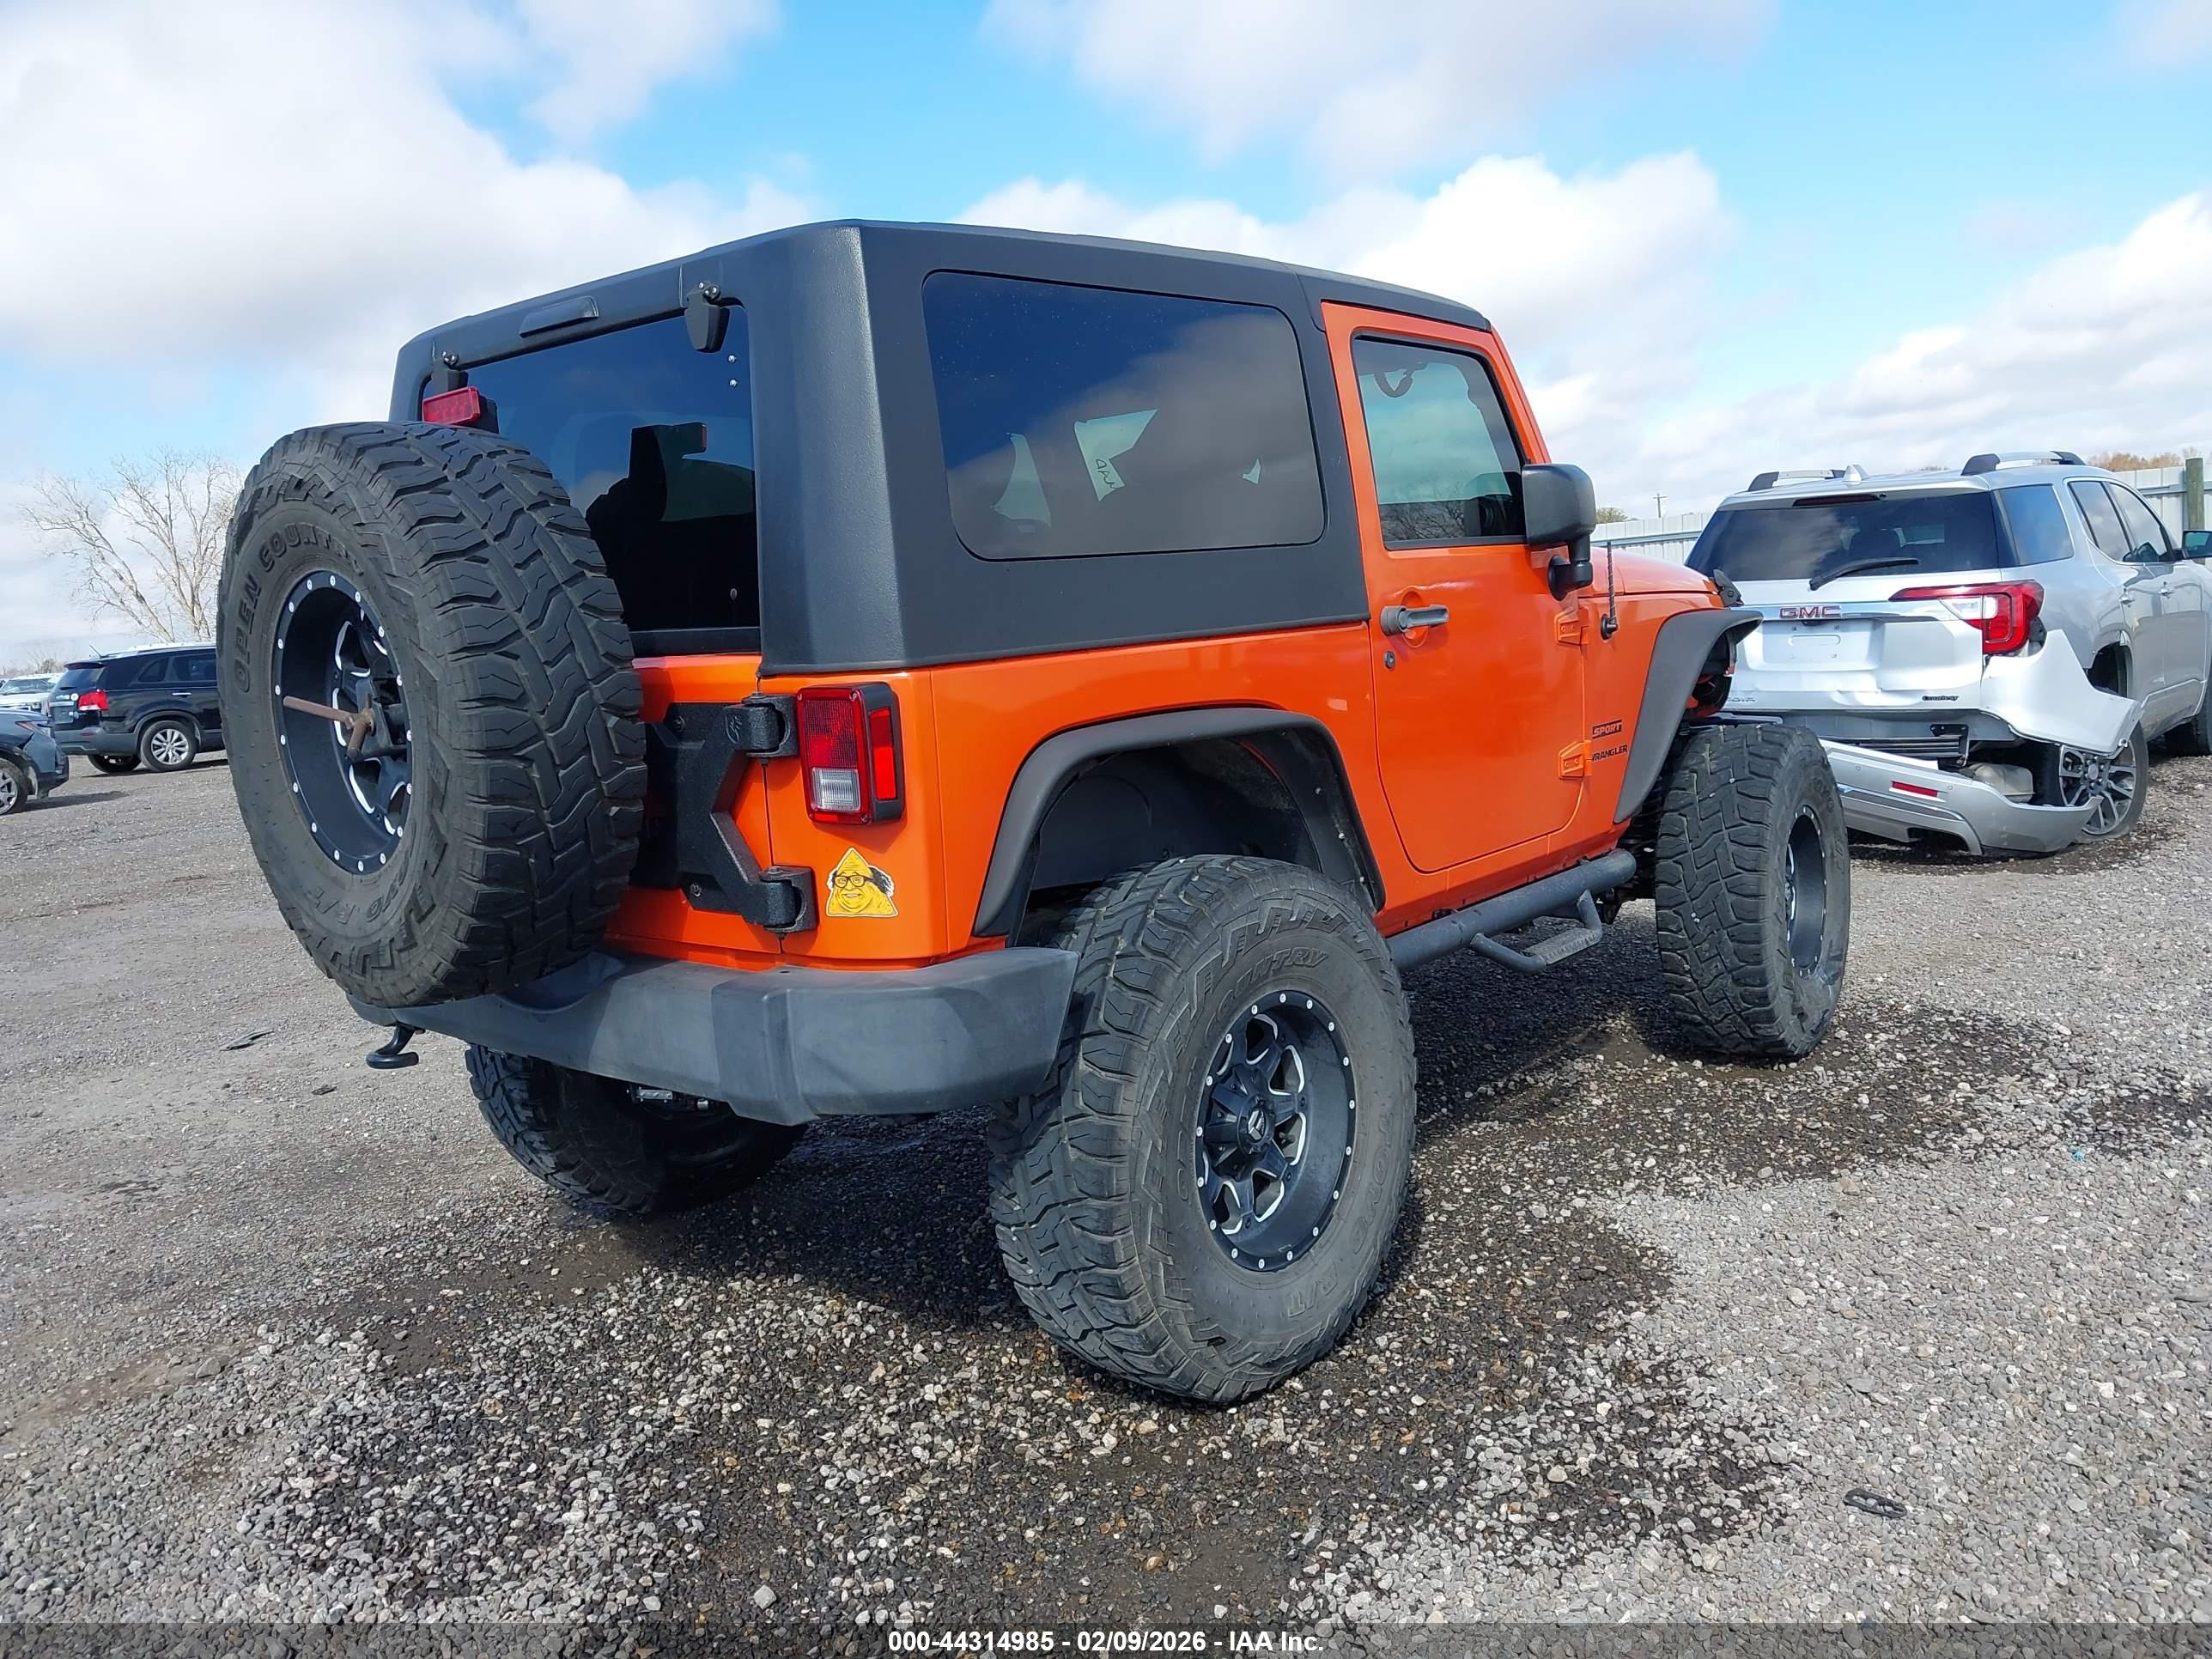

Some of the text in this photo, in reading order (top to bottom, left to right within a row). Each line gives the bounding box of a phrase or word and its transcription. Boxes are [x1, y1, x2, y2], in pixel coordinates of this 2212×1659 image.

[234, 523, 364, 693] OPEN COUNTRY
[1778, 605, 1842, 619] GMC
[1592, 720, 1622, 738] SPORT
